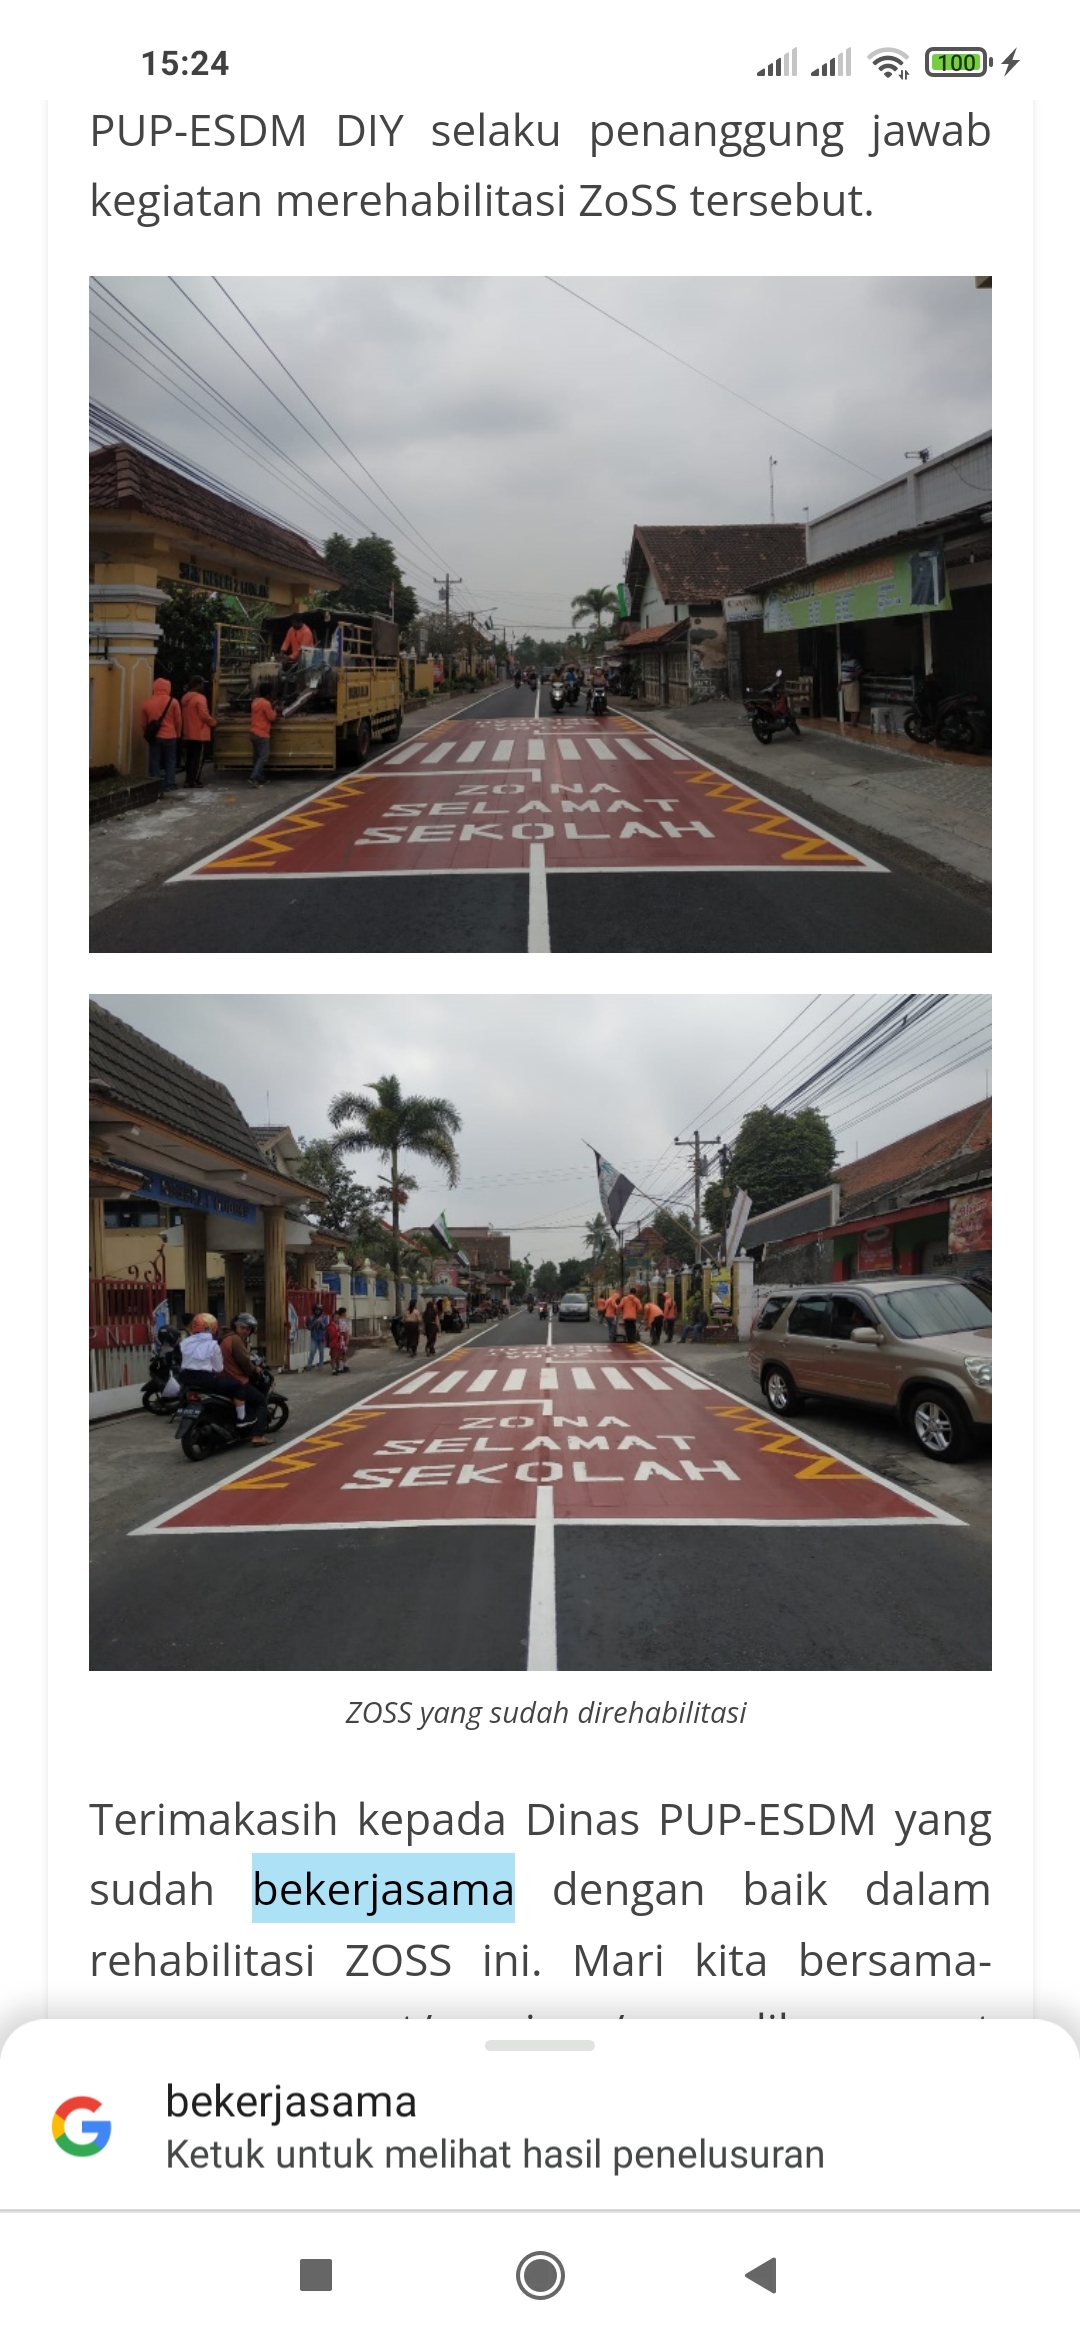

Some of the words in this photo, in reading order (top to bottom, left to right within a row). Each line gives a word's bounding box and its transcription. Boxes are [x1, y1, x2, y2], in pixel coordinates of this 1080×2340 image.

[143, 51, 229, 76] 15:24
[938, 54, 976, 72] 100
[93, 114, 305, 147] PUP-ESDM
[339, 114, 404, 147] DIY
[432, 112, 559, 147] selaku
[592, 121, 844, 158] penanggung
[868, 111, 991, 158] jawab
[92, 182, 261, 227] kegiatan
[278, 181, 564, 217] merehabilitasi
[579, 184, 677, 217] ZoSS
[689, 181, 872, 217] tersebut.
[382, 799, 679, 818] SELAMAT
[354, 821, 715, 846] SEKOLAH
[373, 1435, 696, 1456] SELAMAT
[340, 1460, 742, 1490] SEKOLAH
[345, 1701, 413, 1724] ZOSS
[417, 1706, 483, 1731] yang
[489, 1700, 569, 1724] sudah
[578, 1700, 748, 1724] direhabilitasi
[89, 1800, 336, 1836] Terimakasih
[359, 1800, 504, 1847] kepada
[528, 1803, 639, 1836] Dinas
[661, 1803, 874, 1836] PUP-ESDM
[894, 1810, 992, 1847] yang
[90, 1870, 212, 1906] sudah
[255, 1870, 513, 1917] bekerjasama
[553, 1870, 703, 1917] dengan
[745, 1870, 828, 1906] baik
[866, 1870, 989, 1906] dalam
[92, 1941, 313, 1977] rehabilitasi
[346, 1944, 451, 1977] ZOSS
[484, 1944, 540, 1977] ini.
[575, 1944, 662, 1977] Mari
[697, 1942, 766, 1977] kita
[801, 1941, 991, 1977] bersama-
[167, 2082, 416, 2127] bekerjasama
[167, 2138, 265, 2169] Ketuk
[277, 2138, 374, 2169] untuk
[386, 2138, 511, 2169] melihat
[524, 2138, 600, 2169] hasil
[614, 2138, 824, 2176] penelusuran
